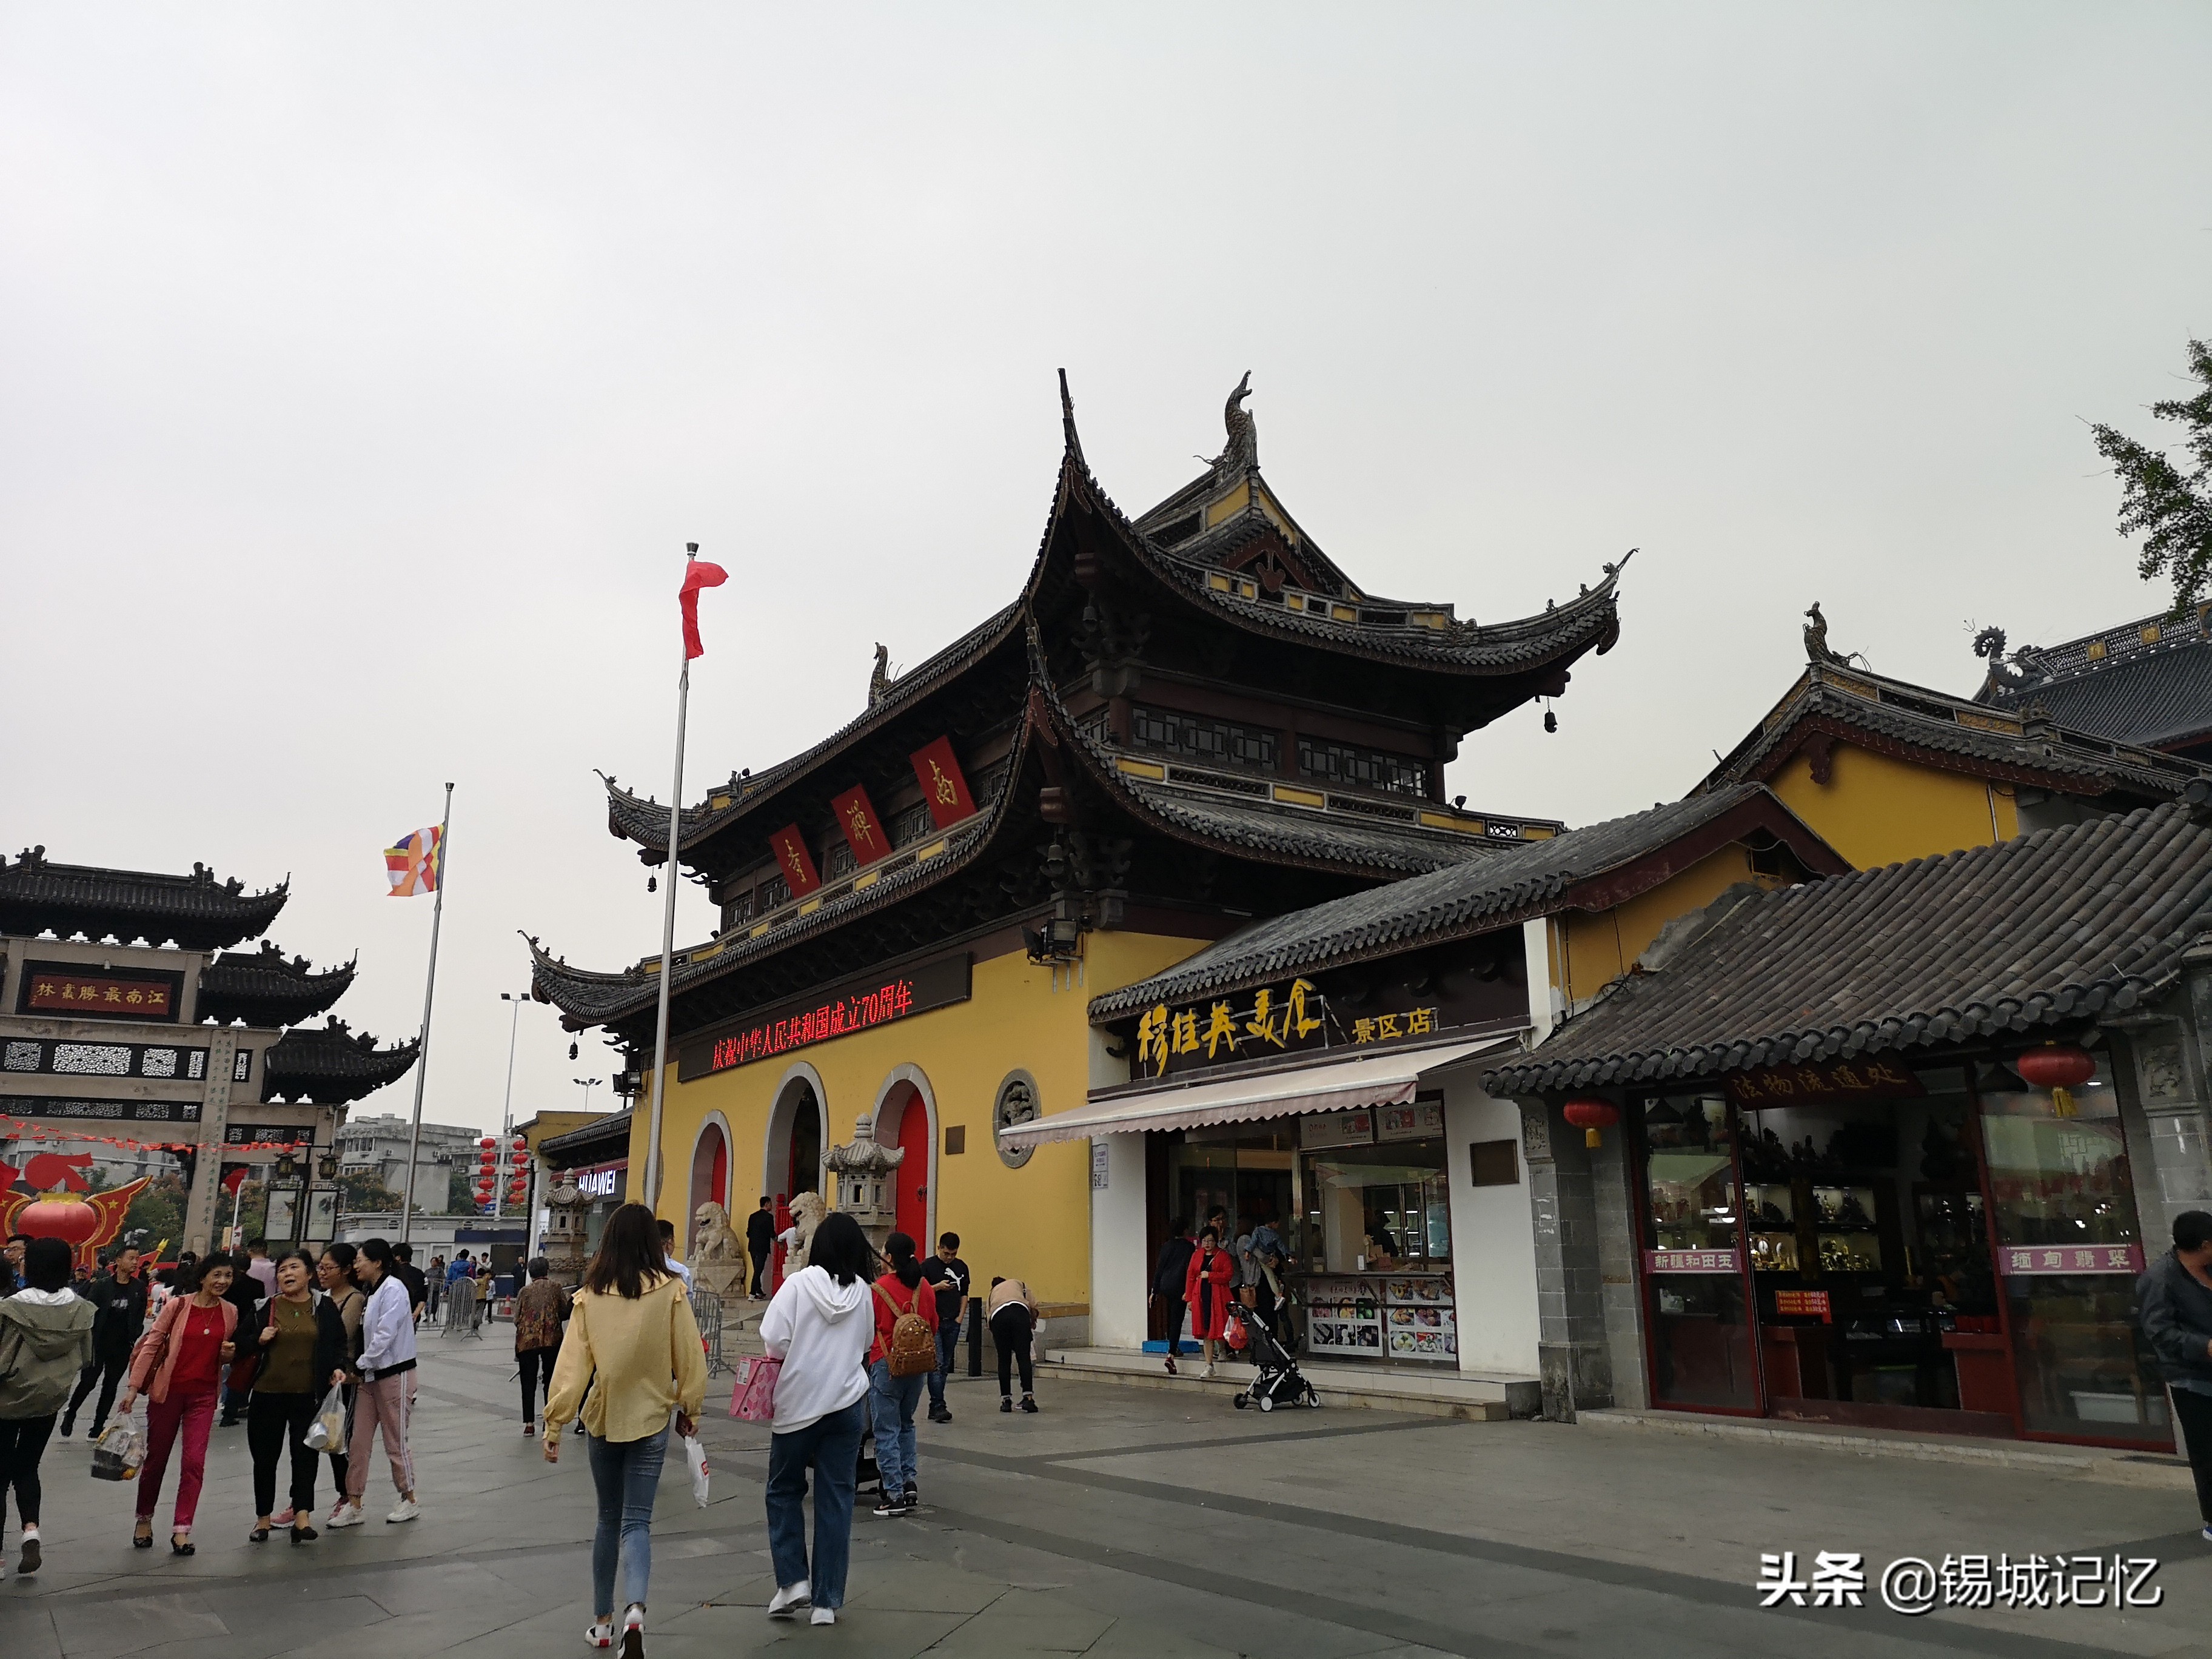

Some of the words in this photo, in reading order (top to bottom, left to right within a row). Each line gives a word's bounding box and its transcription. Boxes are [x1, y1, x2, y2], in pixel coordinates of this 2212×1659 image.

[1137, 977, 1321, 1078] 穆桂英美食
[1351, 1007, 1432, 1044] 景区店
[1732, 1062, 1908, 1099] 法物流通处
[578, 1169, 616, 1196] HUAWEI
[2011, 1249, 2131, 1269] 缅甸翡翠
